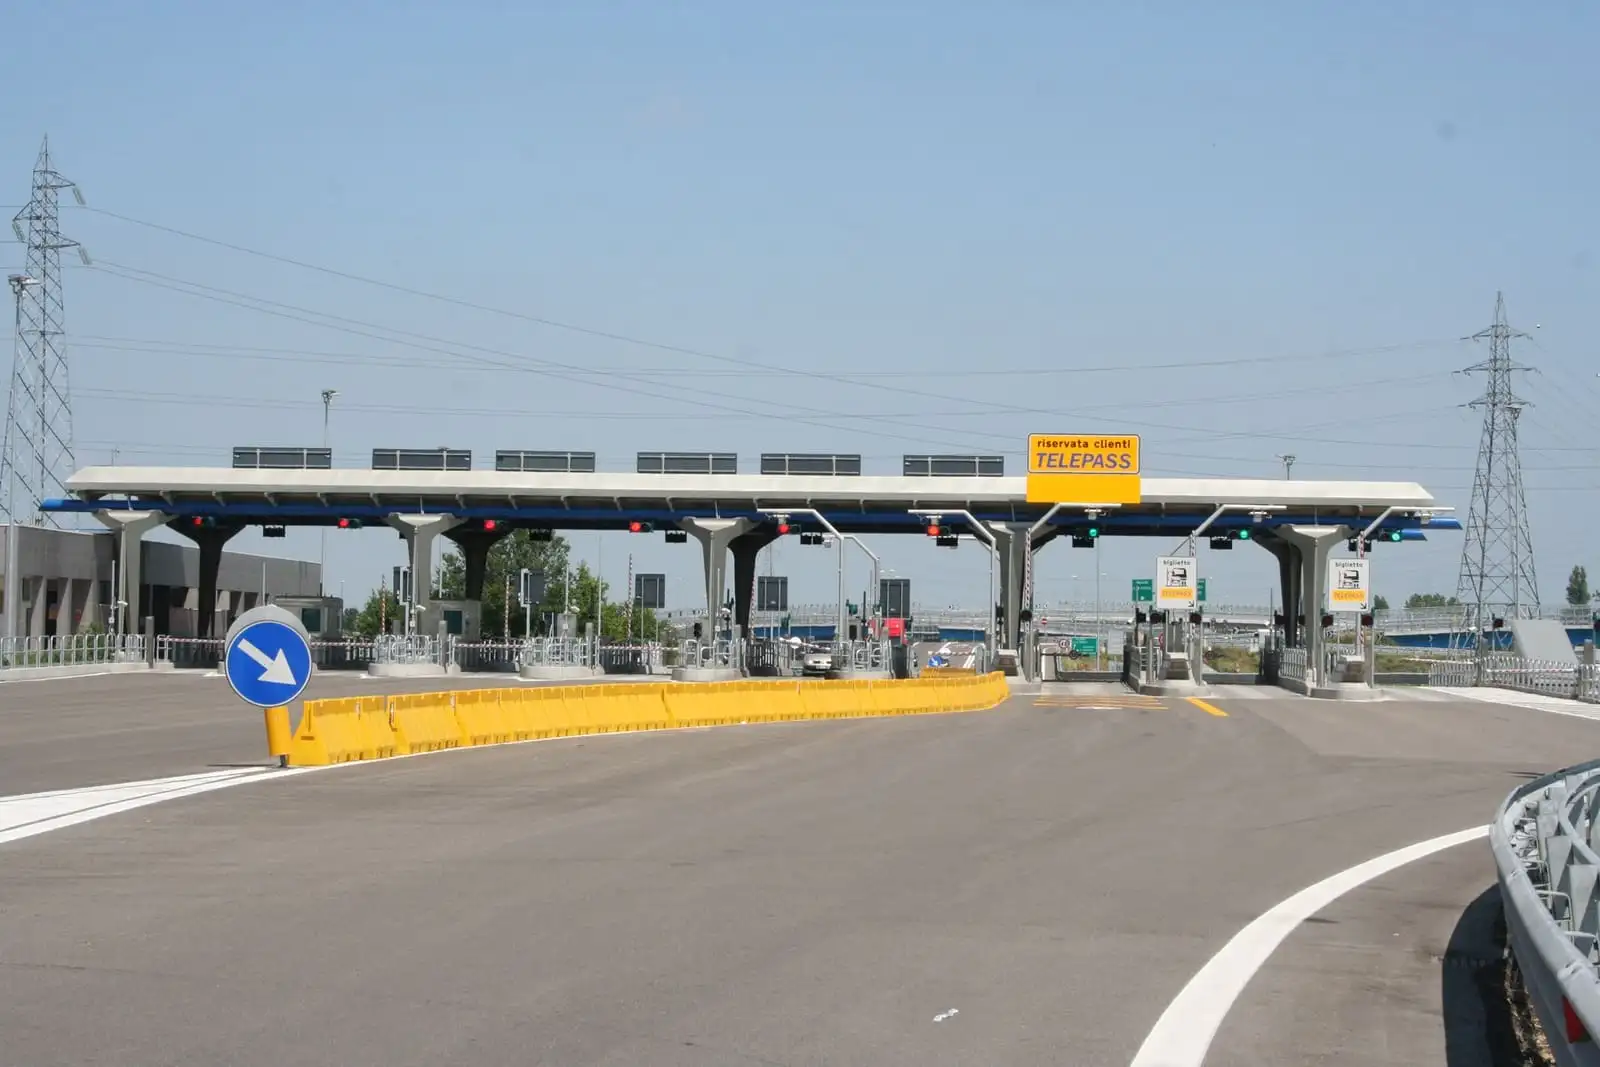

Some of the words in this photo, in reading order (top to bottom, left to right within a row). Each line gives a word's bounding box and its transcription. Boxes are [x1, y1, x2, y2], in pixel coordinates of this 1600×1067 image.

[1037, 439, 1089, 448] riservata
[1094, 439, 1131, 449] clienti
[1036, 452, 1132, 469] TELEPASS
